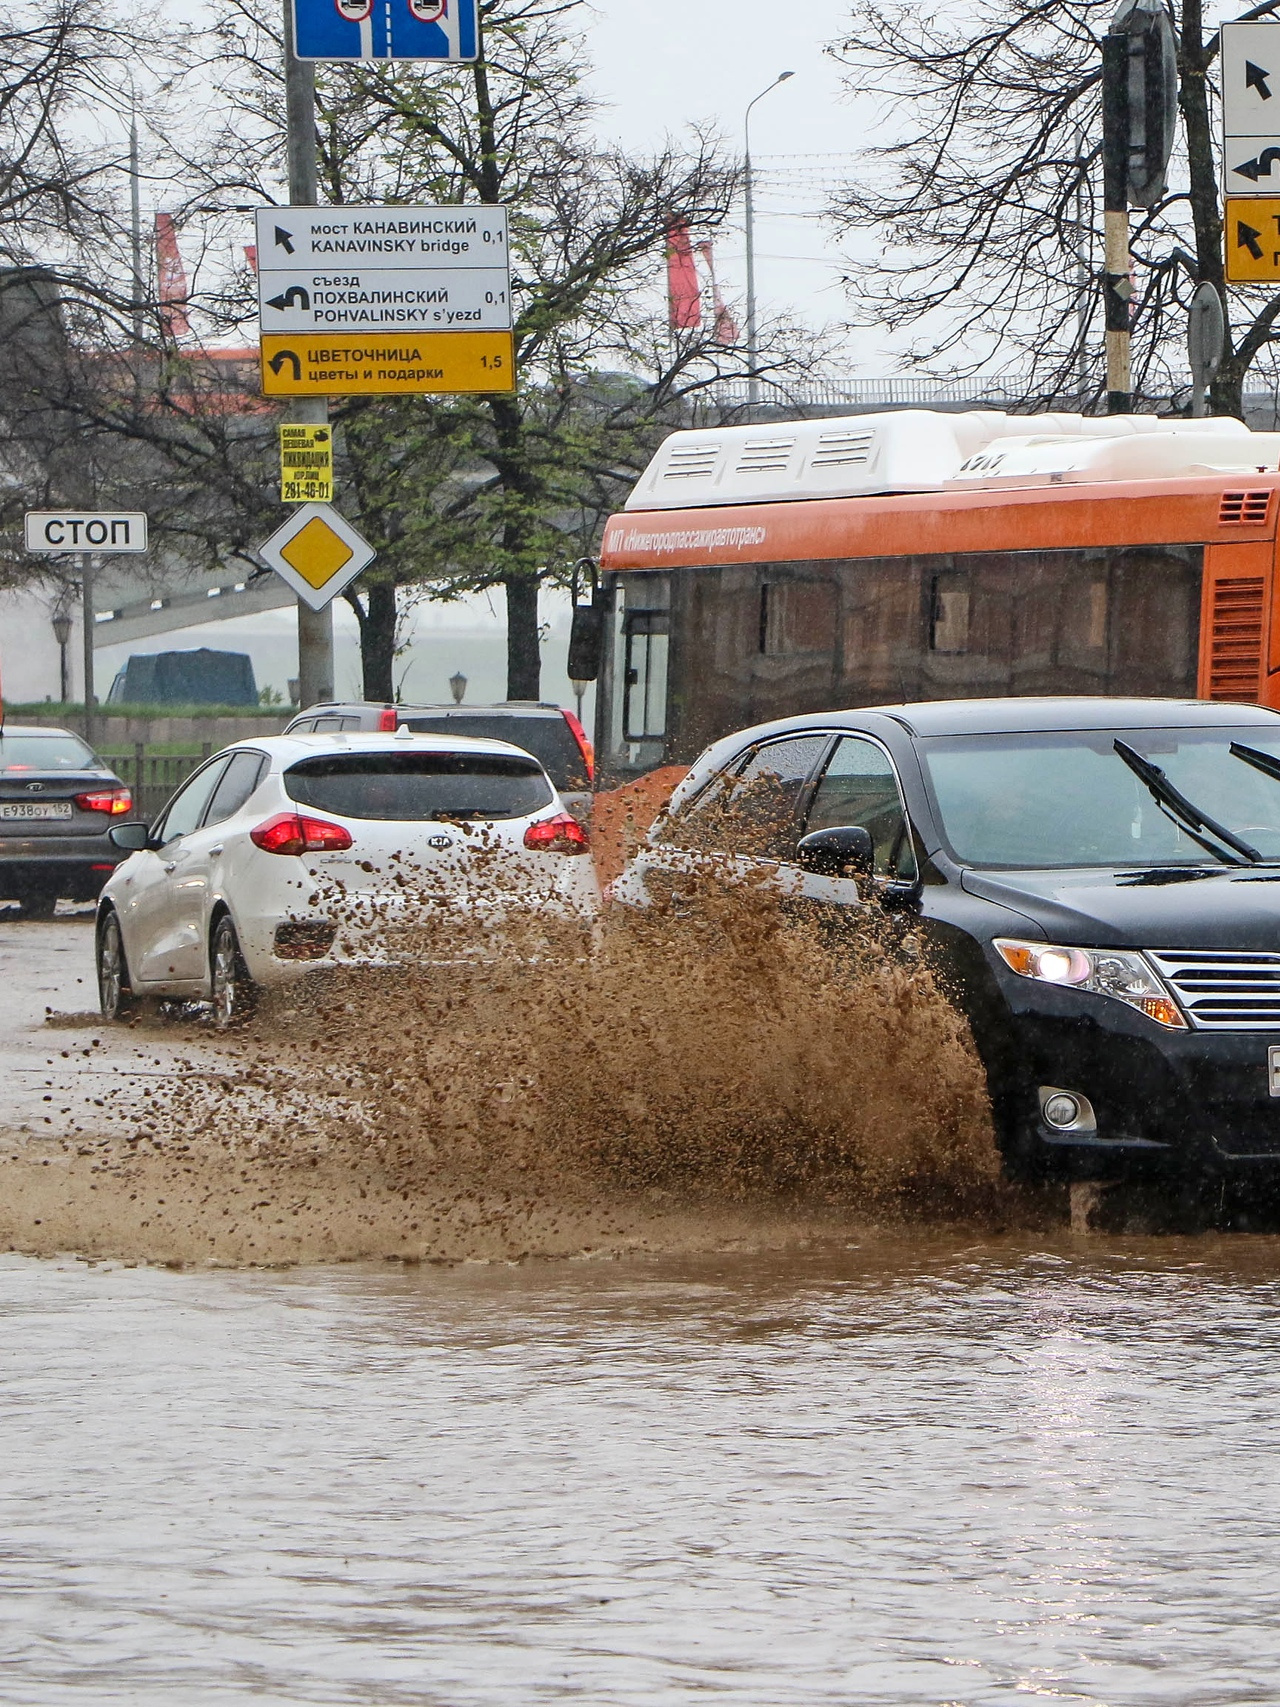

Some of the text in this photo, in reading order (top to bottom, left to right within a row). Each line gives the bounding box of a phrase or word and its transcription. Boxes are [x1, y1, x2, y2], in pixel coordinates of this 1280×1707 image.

[311, 218, 477, 235] мост КАНАВИНСКИЙ
[482, 230, 503, 244] 0,1
[311, 239, 470, 255] KANAVINSKY bridge
[312, 277, 360, 287] съезд
[313, 288, 449, 304] ПОХВАЛИНСКИЙ
[484, 291, 505, 306] 0,1
[314, 309, 428, 322] POHVALINSKY
[308, 347, 422, 364] ЦВЕТОЧНИЦА
[480, 355, 502, 370] 1,5
[308, 368, 443, 382] цветы и подарки
[45, 519, 130, 545] СТОП
[52, 803, 70, 814] 152
[430, 836, 450, 846] KIA
